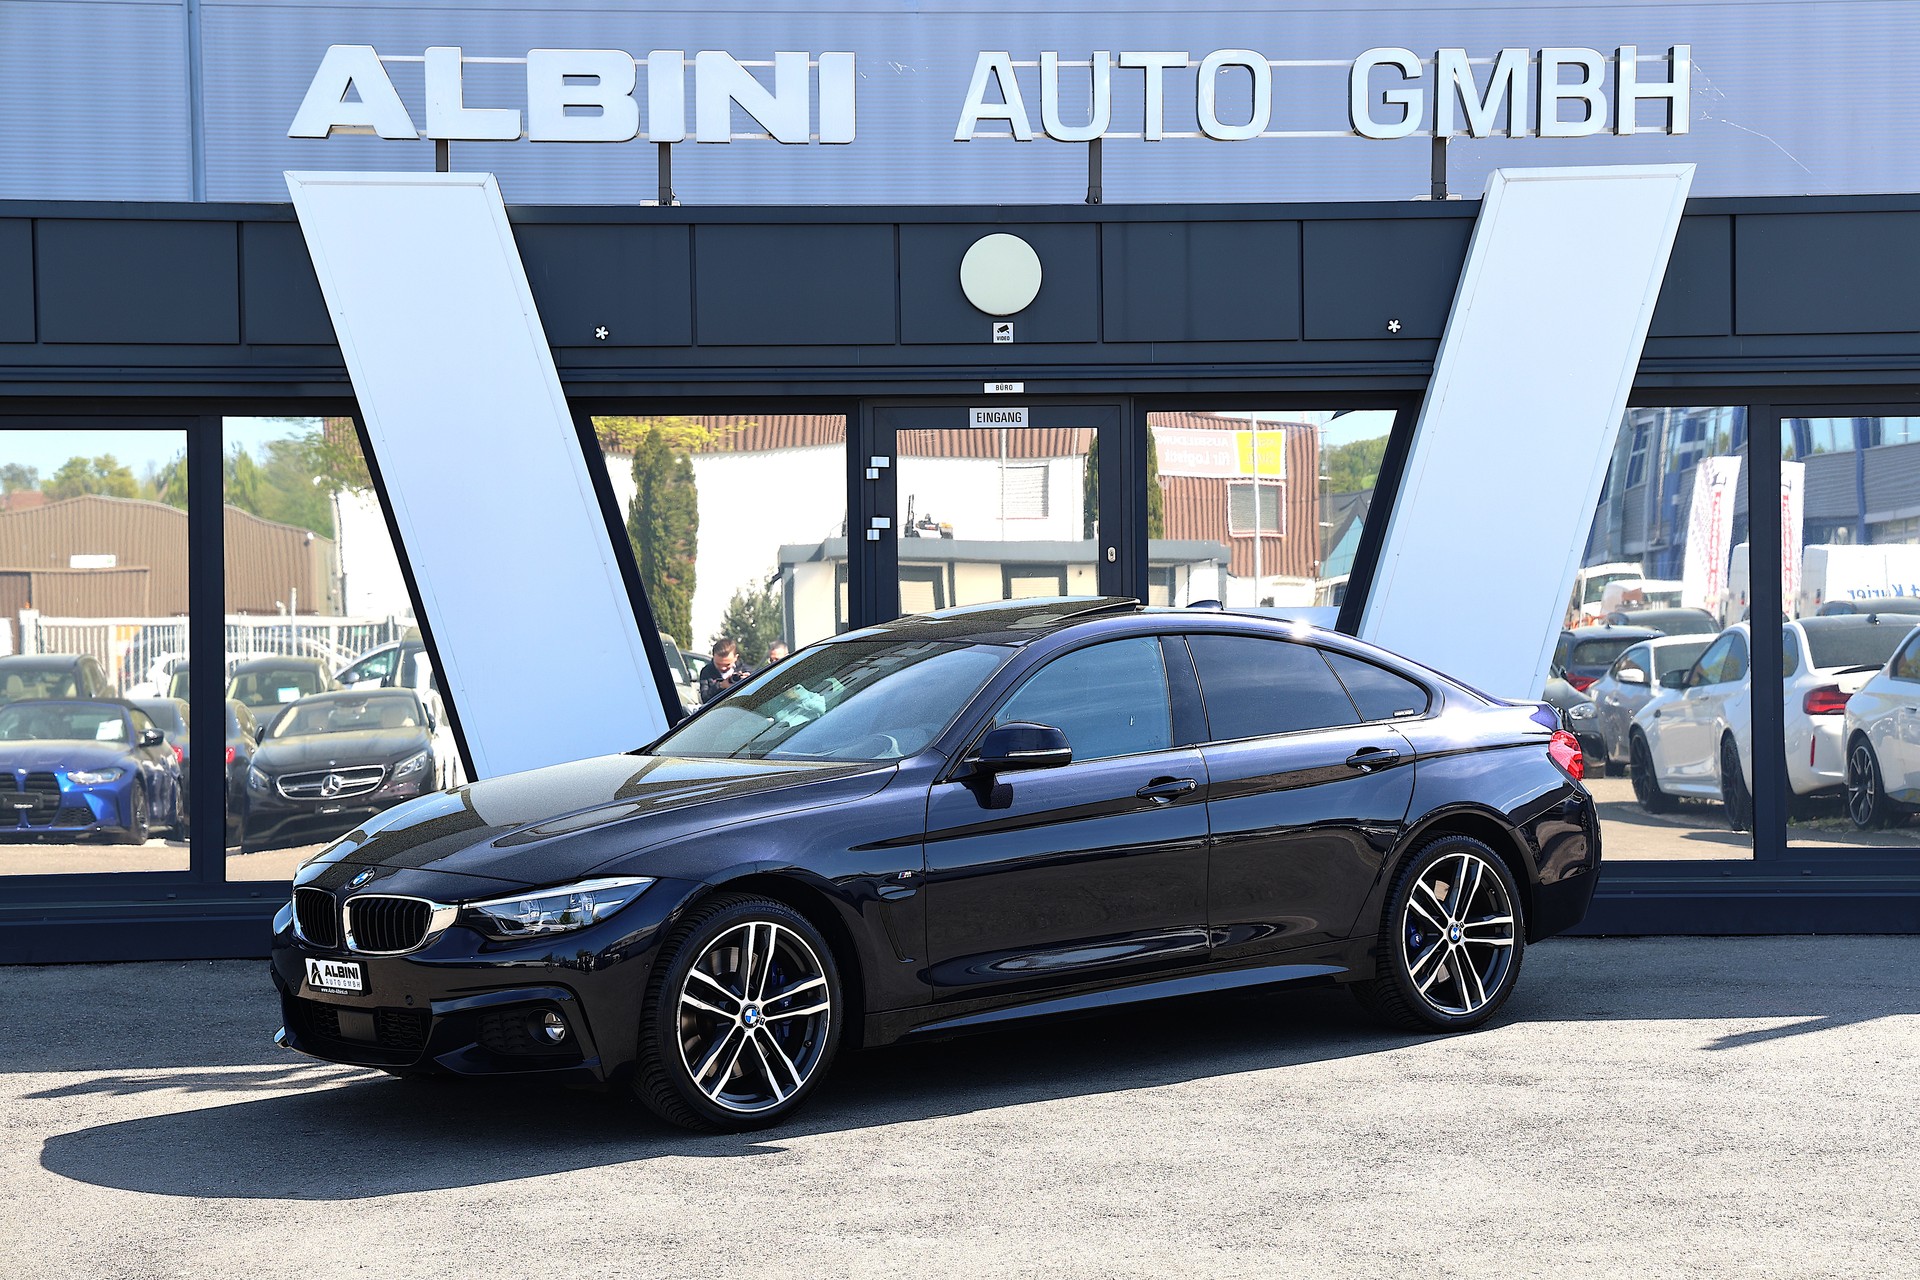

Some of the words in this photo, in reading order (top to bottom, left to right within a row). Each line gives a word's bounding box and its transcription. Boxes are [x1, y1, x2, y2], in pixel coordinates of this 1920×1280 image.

[287, 44, 856, 144] ALBINI
[953, 47, 1273, 143] AUTO
[1349, 43, 1692, 141] GMBH
[976, 411, 1022, 423] EINGANG
[325, 964, 359, 979] ALBINI
